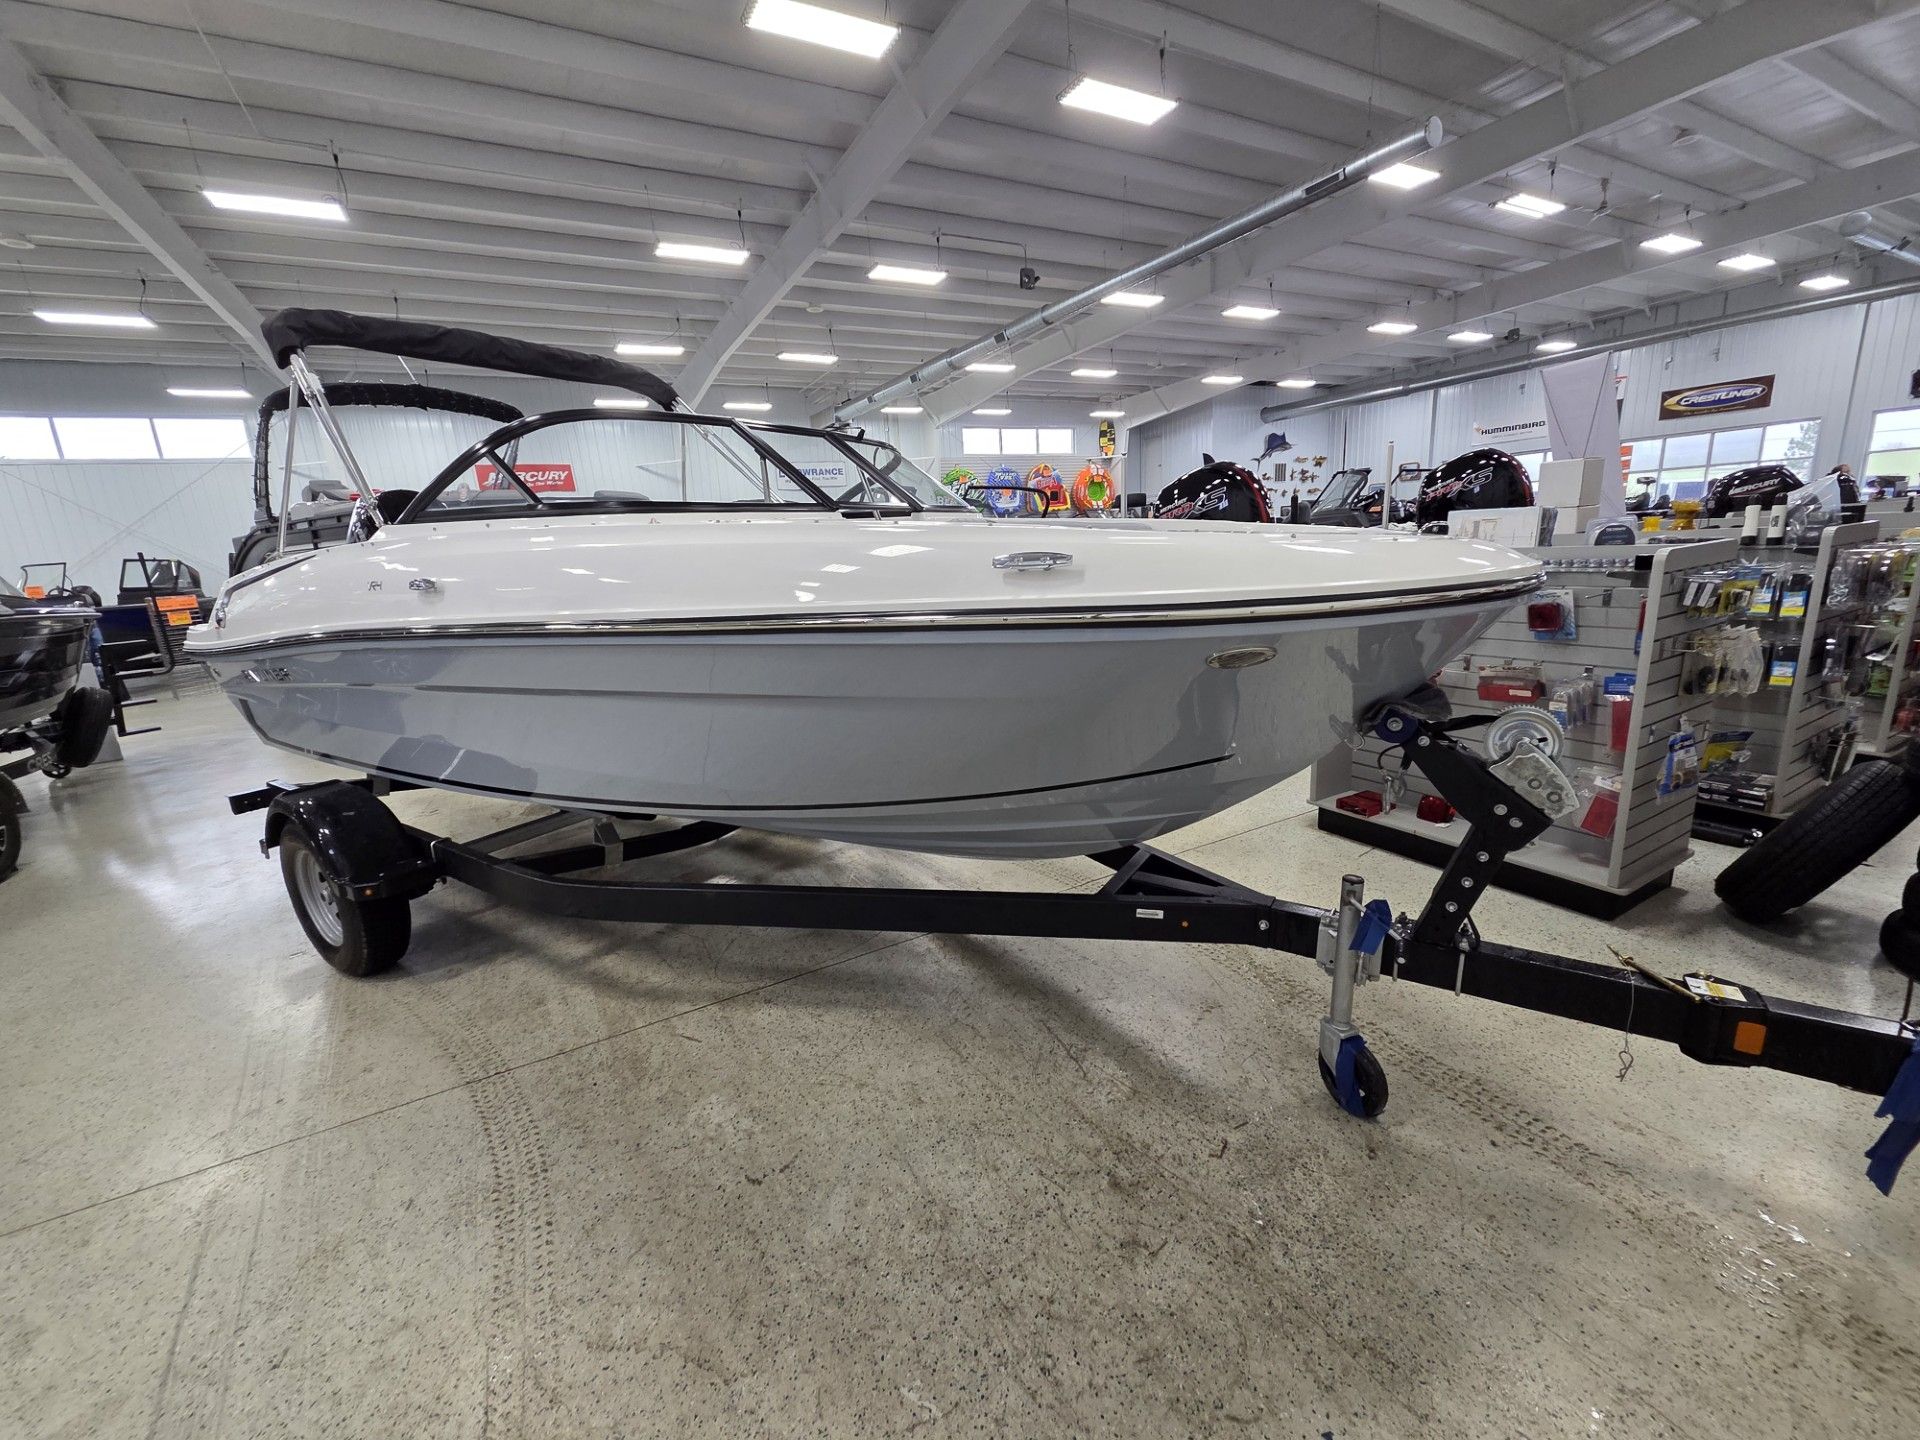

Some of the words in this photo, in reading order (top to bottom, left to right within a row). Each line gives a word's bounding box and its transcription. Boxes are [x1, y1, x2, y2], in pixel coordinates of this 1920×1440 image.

[1680, 387, 1763, 405] CRESTLINER
[1481, 421, 1546, 435] HUMMINBIRD
[1728, 477, 1782, 495] MERCURY
